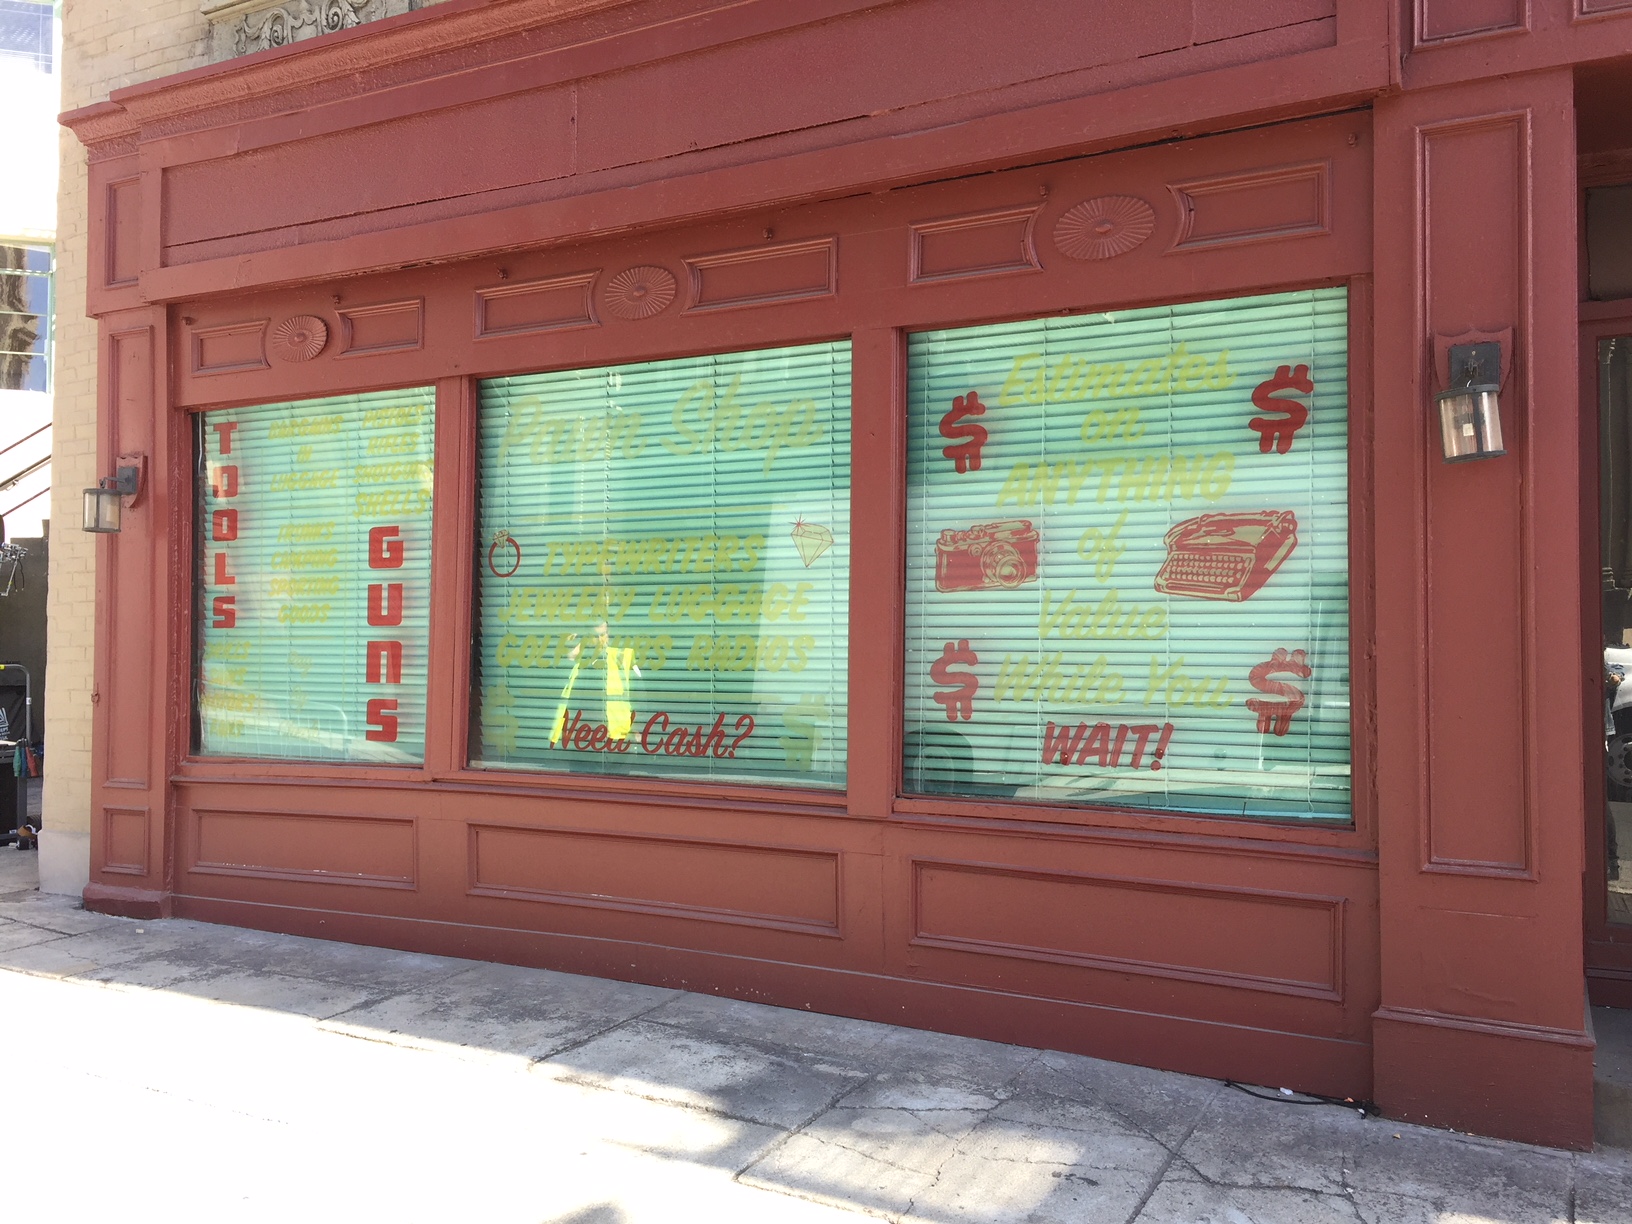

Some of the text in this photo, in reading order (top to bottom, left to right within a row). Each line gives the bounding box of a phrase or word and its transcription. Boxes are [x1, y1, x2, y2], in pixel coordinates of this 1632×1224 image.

[997, 341, 1237, 406] Estimates
[268, 415, 344, 441] BARGAINS
[362, 404, 425, 429] PISTOLS
[496, 371, 823, 478] Pawn Shop
[1079, 407, 1145, 445] on
[297, 444, 313, 464] IN
[366, 432, 420, 456] RIFLES
[270, 468, 340, 492] LUGGAGE
[352, 458, 434, 484] SHOTGUNS
[996, 451, 1236, 508] ANYTHING
[352, 489, 431, 518] SHELLS
[212, 421, 238, 628] TOOLS
[277, 521, 336, 543] TRUNKS
[1077, 507, 1129, 583] of
[271, 547, 339, 570] CAMPING
[542, 533, 766, 577] TYPEWRITERS
[268, 576, 340, 597] SPORTING
[497, 582, 814, 623] JEWLERY LUGGAGE
[277, 604, 331, 624] GOODS
[366, 526, 404, 742] GUNS
[1038, 588, 1169, 641] Value
[495, 632, 574, 669] GOLF
[687, 634, 816, 673] RADIOS
[994, 651, 1238, 711] While You
[641, 711, 755, 759] Cash?
[1041, 721, 1174, 772] WAIT!
